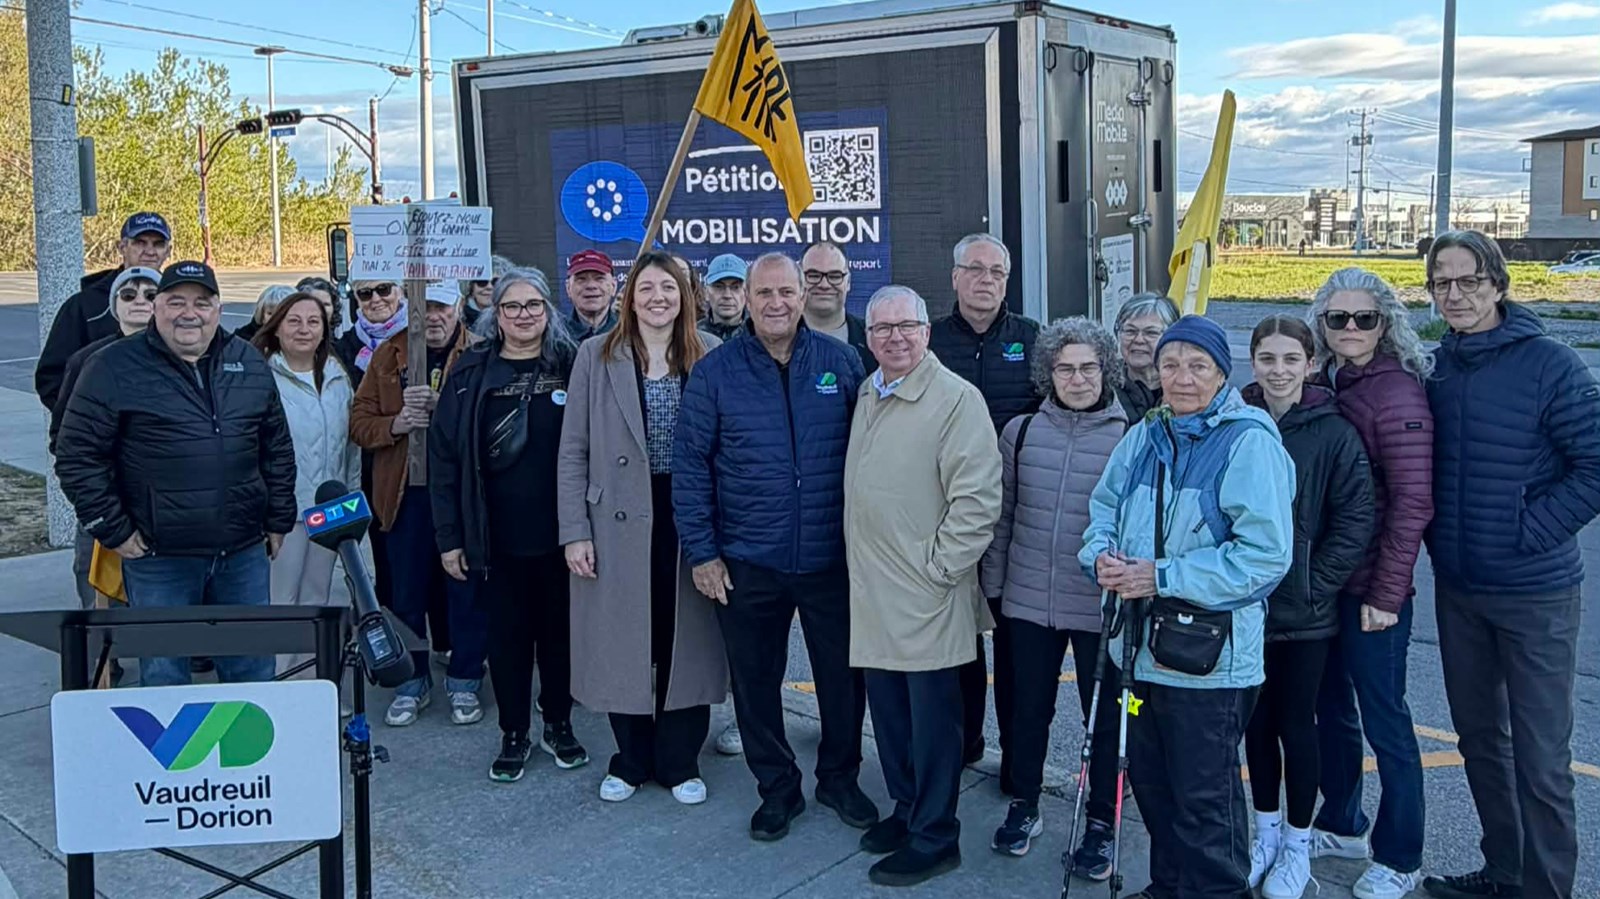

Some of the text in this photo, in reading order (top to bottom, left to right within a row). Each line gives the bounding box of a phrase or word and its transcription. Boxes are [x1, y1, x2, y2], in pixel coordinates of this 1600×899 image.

[387, 220, 411, 236] ON
[662, 216, 880, 244] MOBILISATION
[355, 242, 367, 257] LE
[307, 497, 360, 527] CTV
[134, 774, 272, 806] Vaudreuil
[177, 804, 273, 831] Dorion
